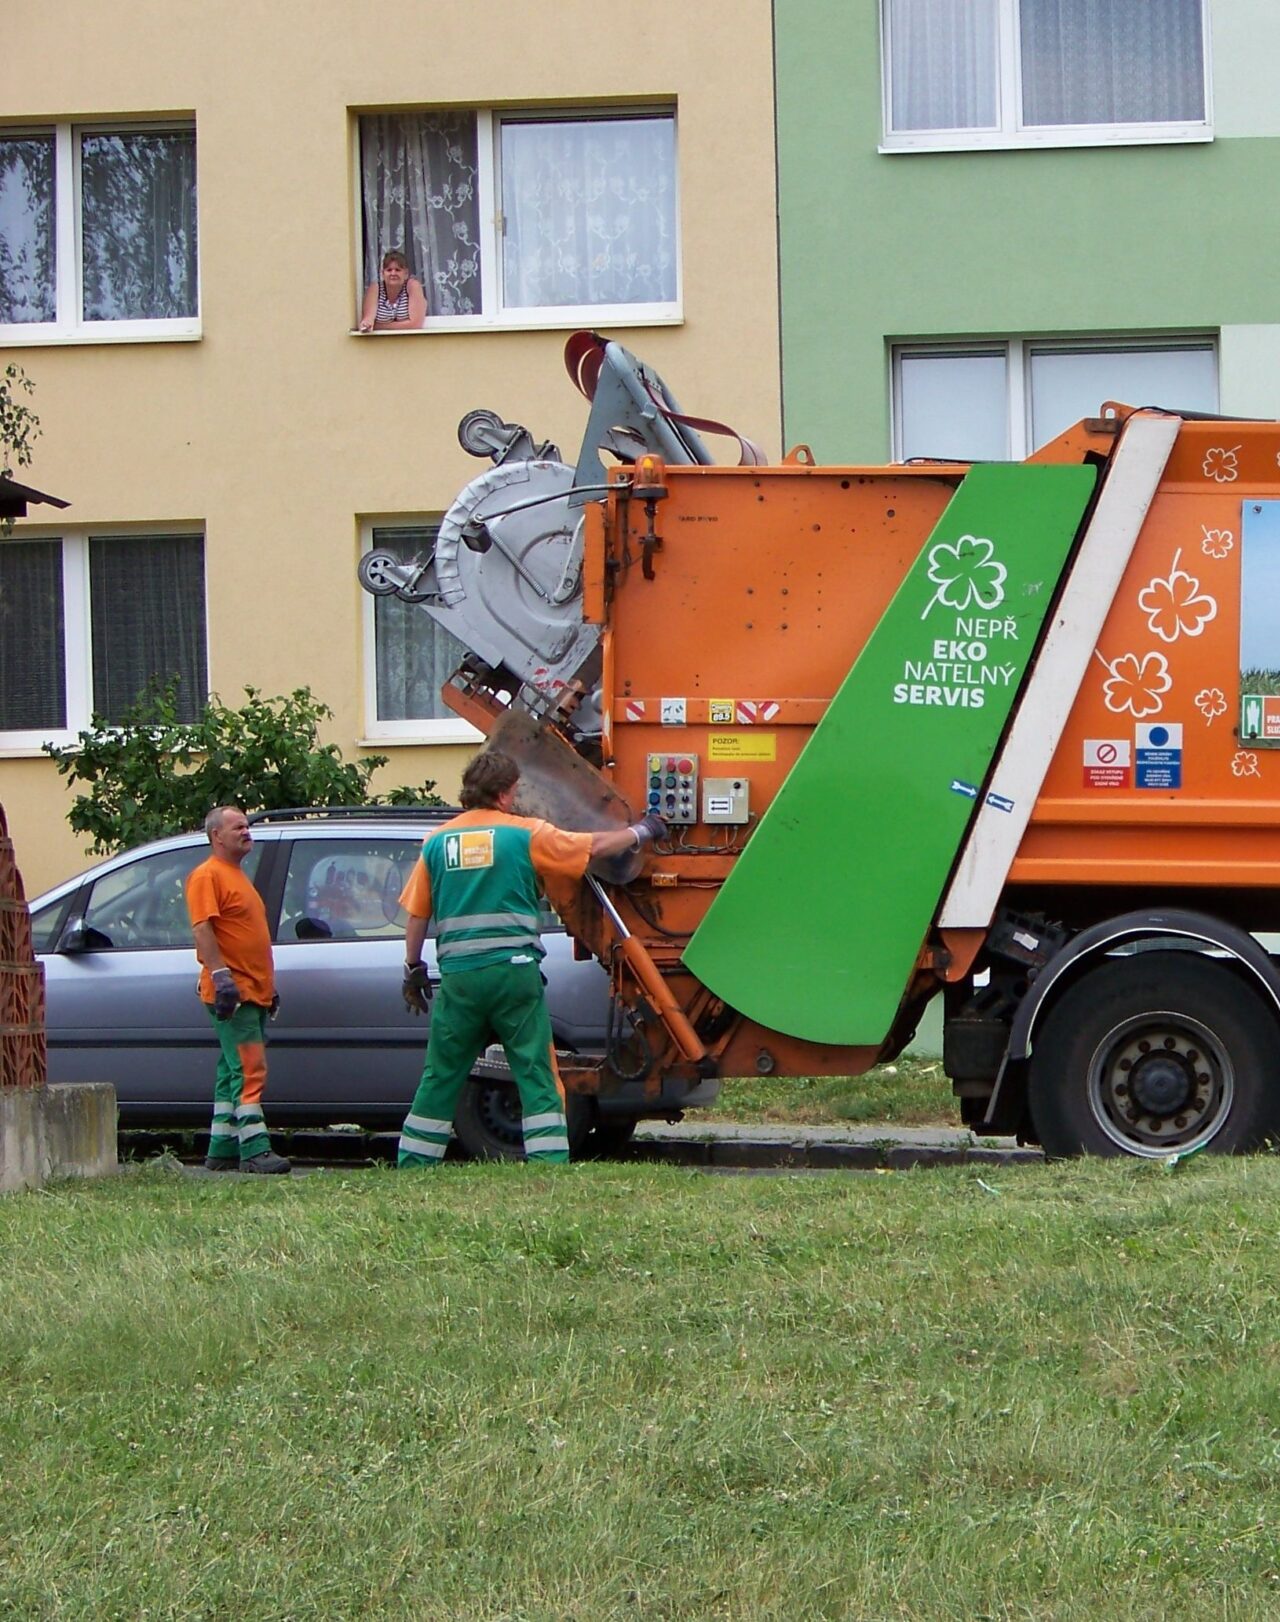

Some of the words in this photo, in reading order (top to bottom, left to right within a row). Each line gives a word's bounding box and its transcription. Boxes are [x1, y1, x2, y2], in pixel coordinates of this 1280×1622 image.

[955, 615, 1019, 640] NEPŘ
[933, 639, 987, 661] EKO
[904, 661, 1017, 686] NATELNÝ
[893, 684, 985, 708] SERVIS
